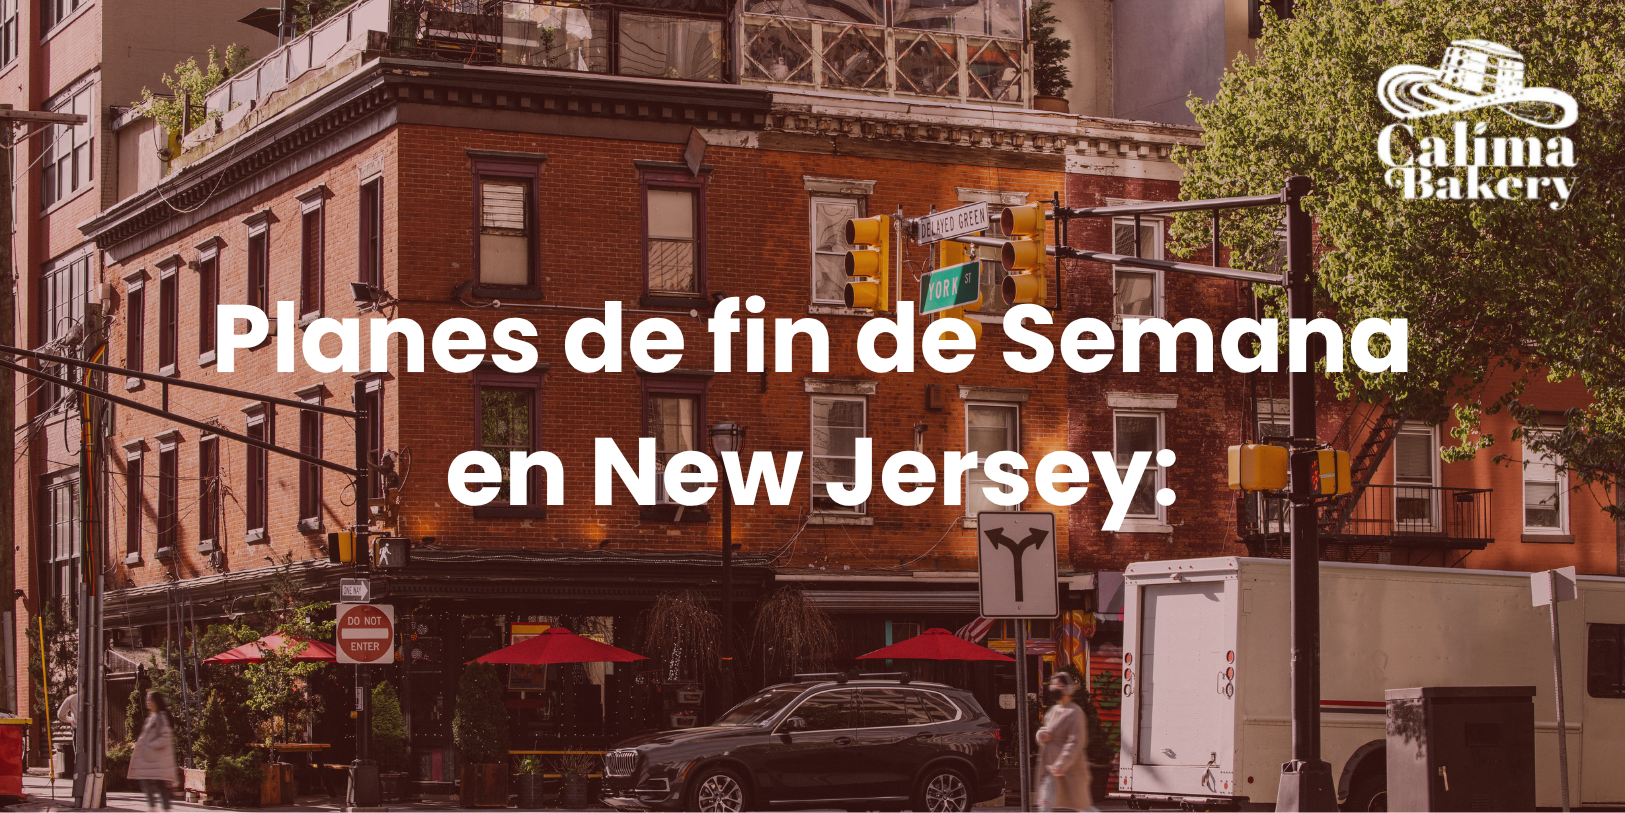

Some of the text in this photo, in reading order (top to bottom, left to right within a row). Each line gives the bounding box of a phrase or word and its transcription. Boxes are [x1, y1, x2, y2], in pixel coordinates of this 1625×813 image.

[921, 208, 985, 239] DELAYED GREEN
[928, 272, 972, 301] YORK ST
[343, 586, 361, 594] ONE WAY
[347, 616, 382, 626] DO NOT
[350, 641, 380, 651] ENTER
